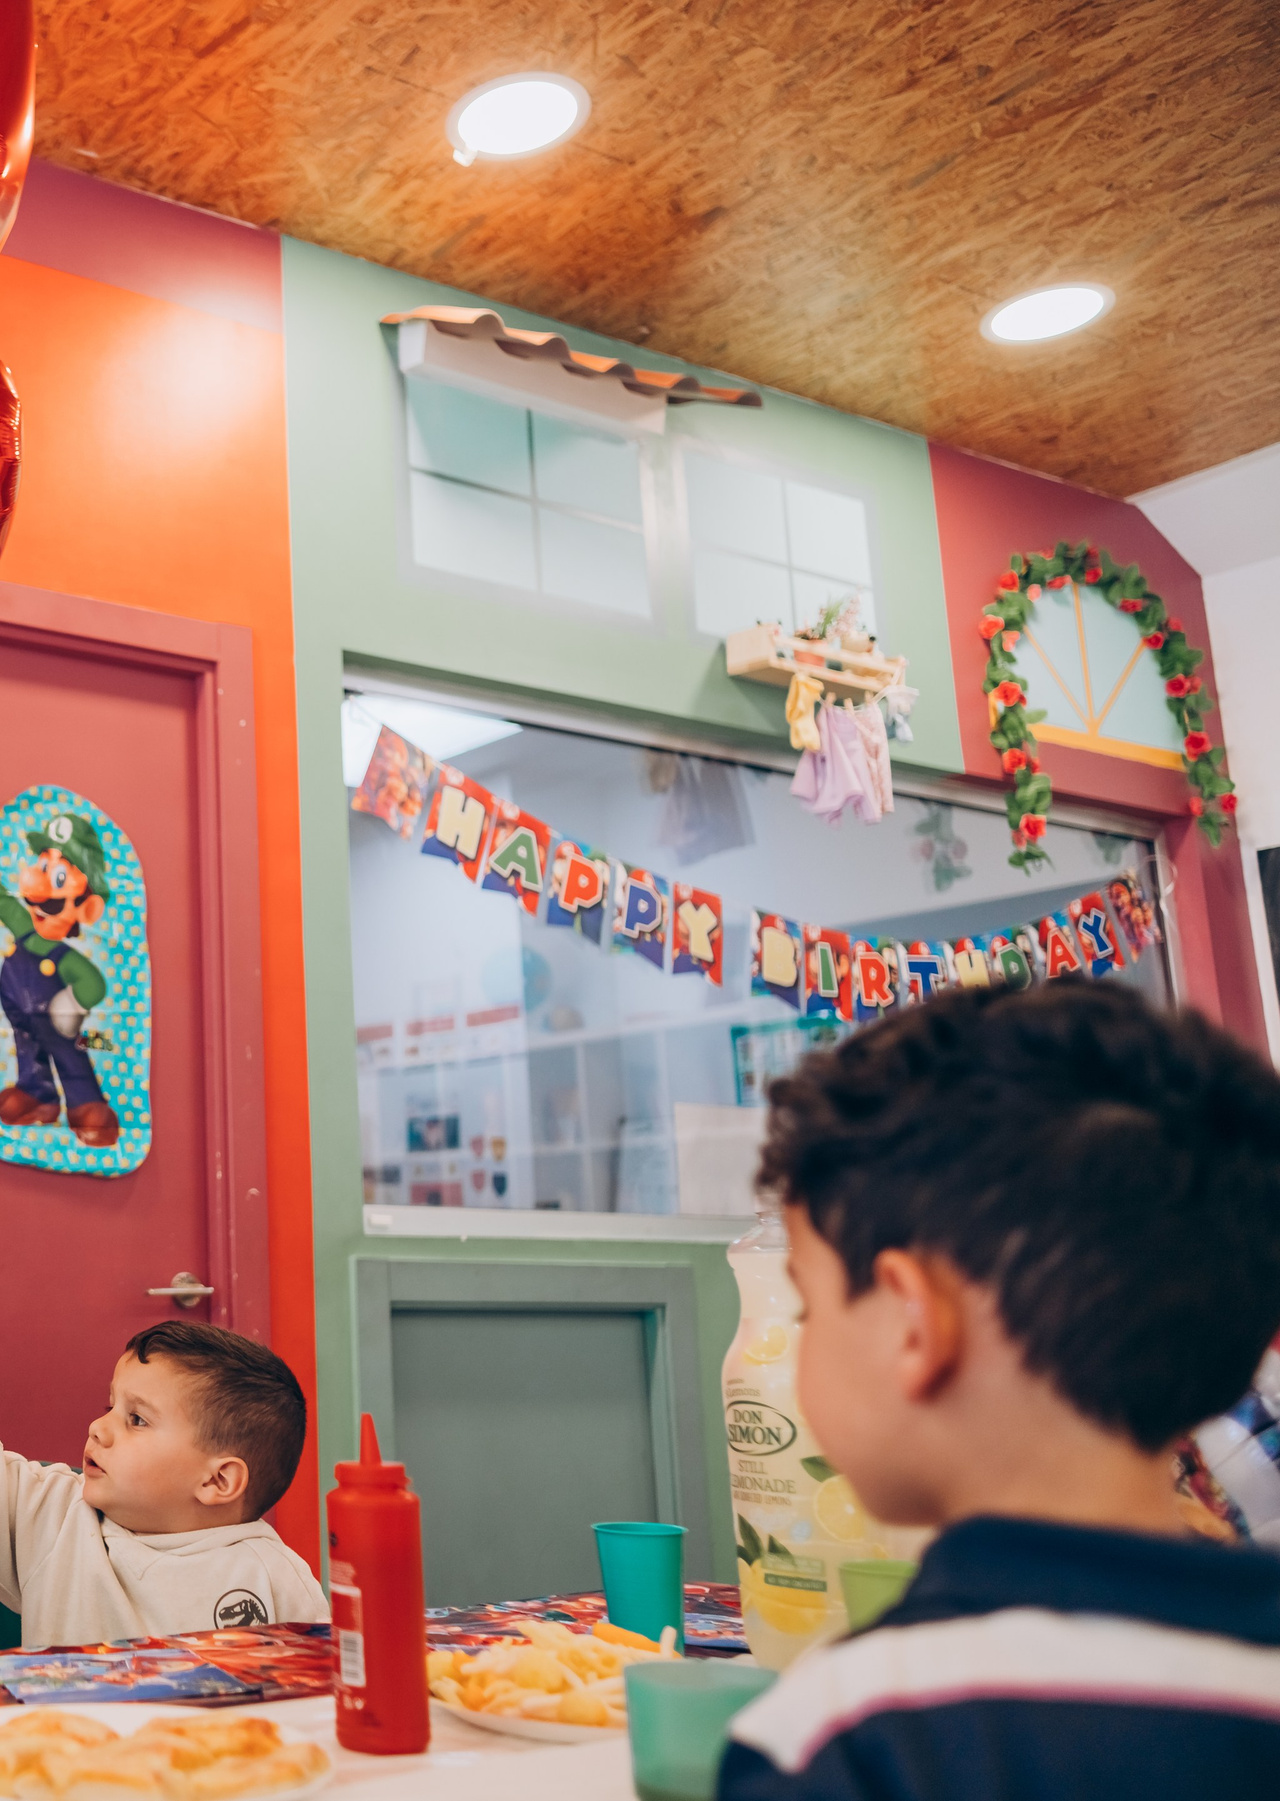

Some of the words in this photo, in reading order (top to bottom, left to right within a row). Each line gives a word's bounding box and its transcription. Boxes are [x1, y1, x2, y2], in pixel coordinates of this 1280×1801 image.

[435, 784, 718, 963] HAPPY
[761, 906, 1116, 1007] BIRTHDAY
[733, 1409, 763, 1424] DON
[728, 1424, 782, 1445] SIMON
[738, 1460, 768, 1474] STILL
[730, 1474, 797, 1494] EMONADE
